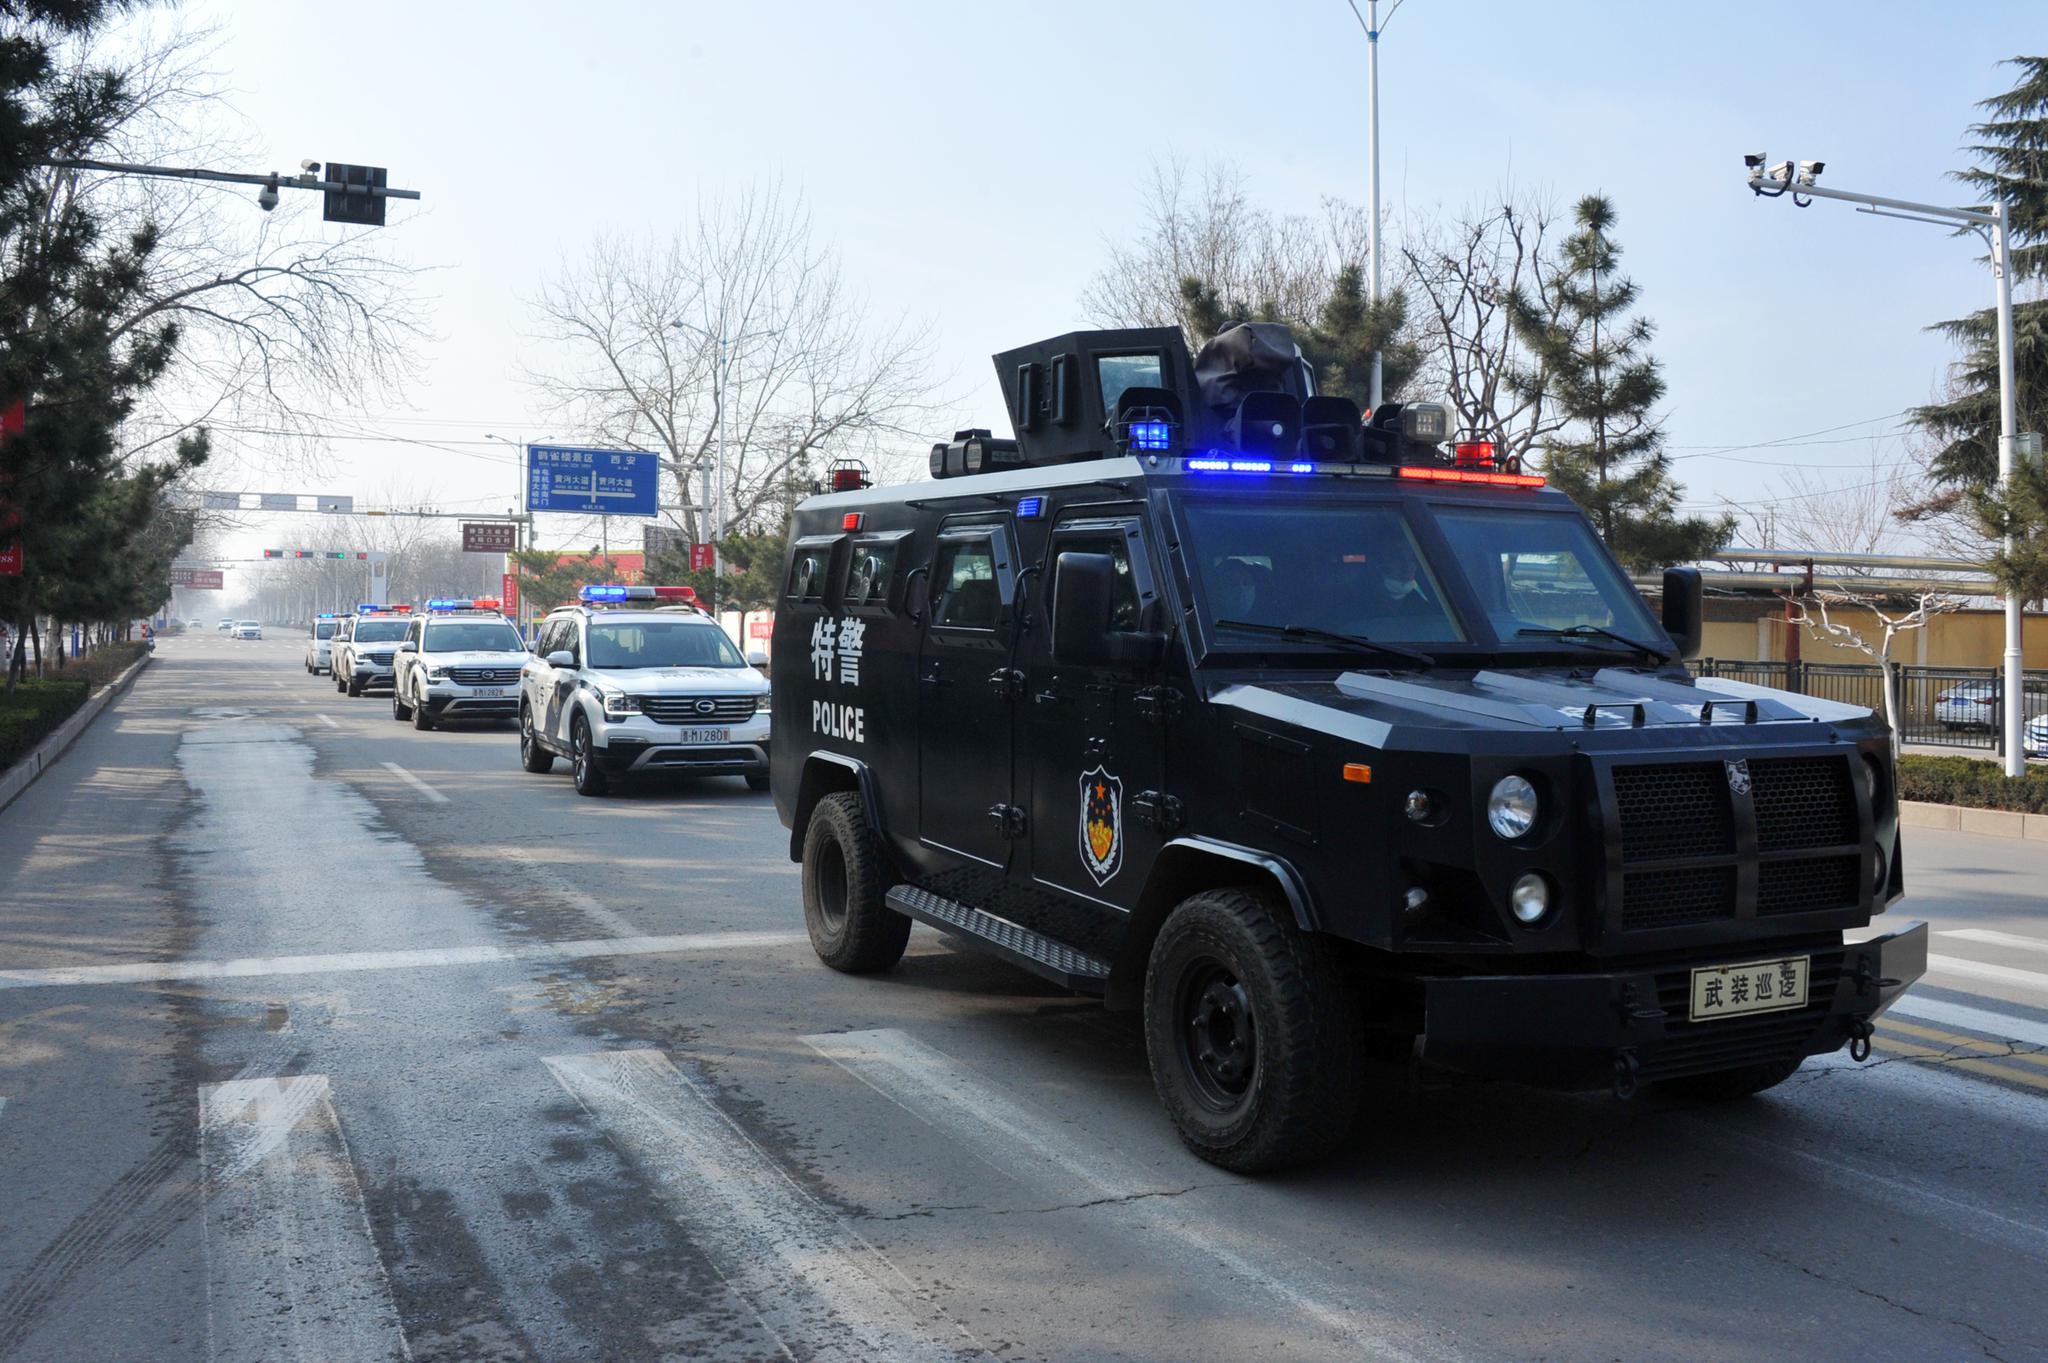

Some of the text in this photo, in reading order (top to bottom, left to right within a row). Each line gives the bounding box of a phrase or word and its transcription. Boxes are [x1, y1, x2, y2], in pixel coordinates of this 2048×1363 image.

[610, 455, 636, 465] 西安
[811, 616, 866, 686] 特警
[813, 700, 864, 743] POLICE
[1704, 966, 1796, 1008] 武装巡逻
